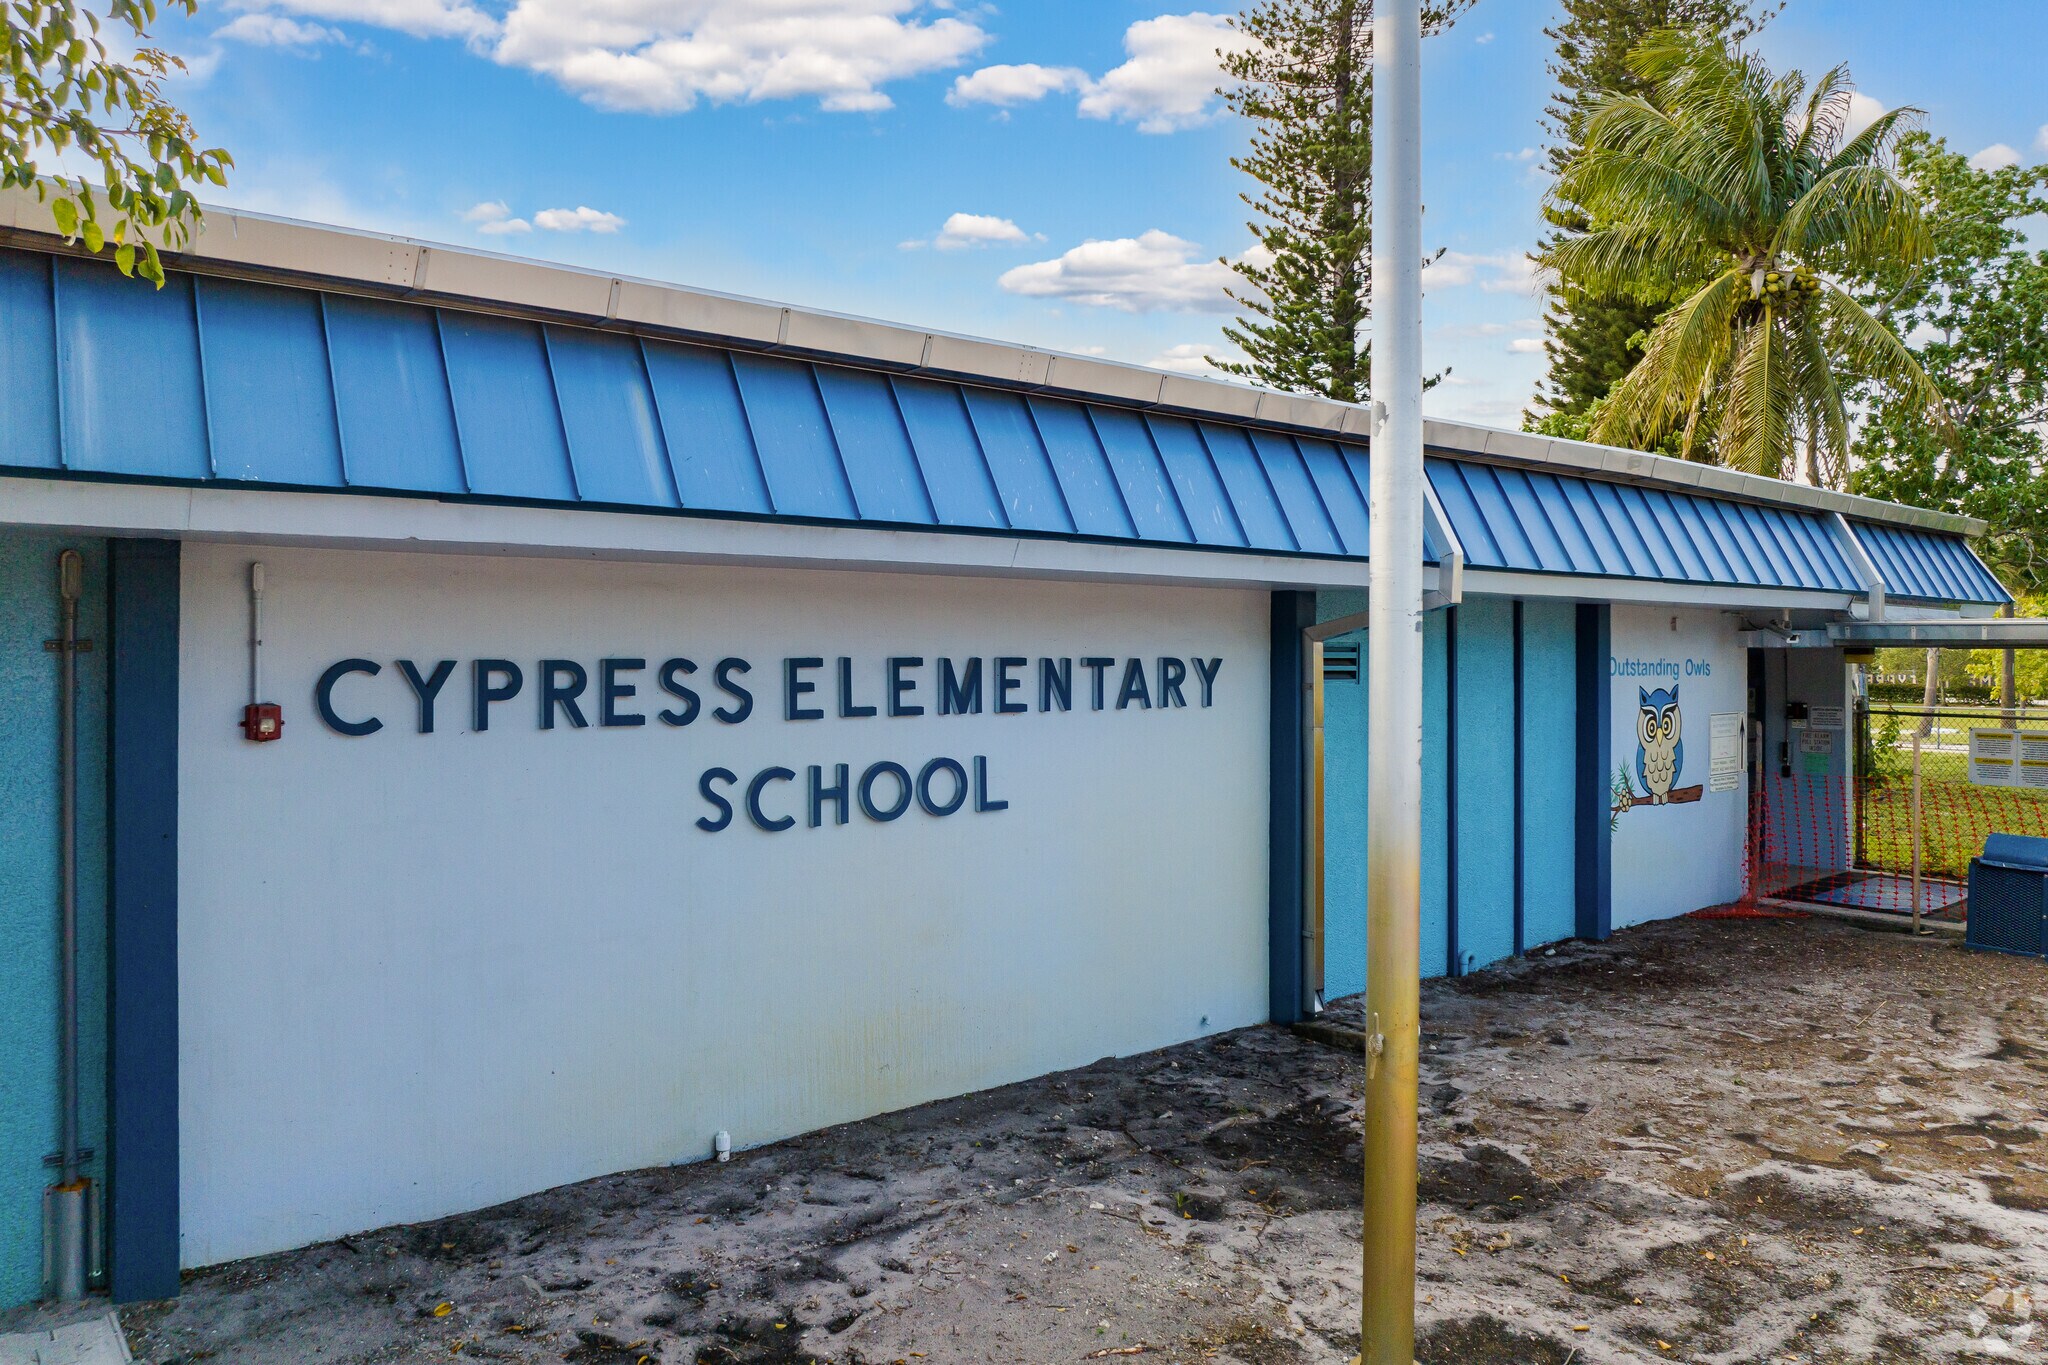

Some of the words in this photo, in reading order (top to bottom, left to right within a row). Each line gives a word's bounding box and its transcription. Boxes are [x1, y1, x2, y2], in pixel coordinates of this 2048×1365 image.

[313, 656, 755, 738] CYPRESS
[783, 656, 1224, 722] ELEMENTARY
[1611, 656, 1679, 680] Outstanding
[1685, 658, 1711, 677] Owls
[694, 755, 1010, 834] SCHOOL
